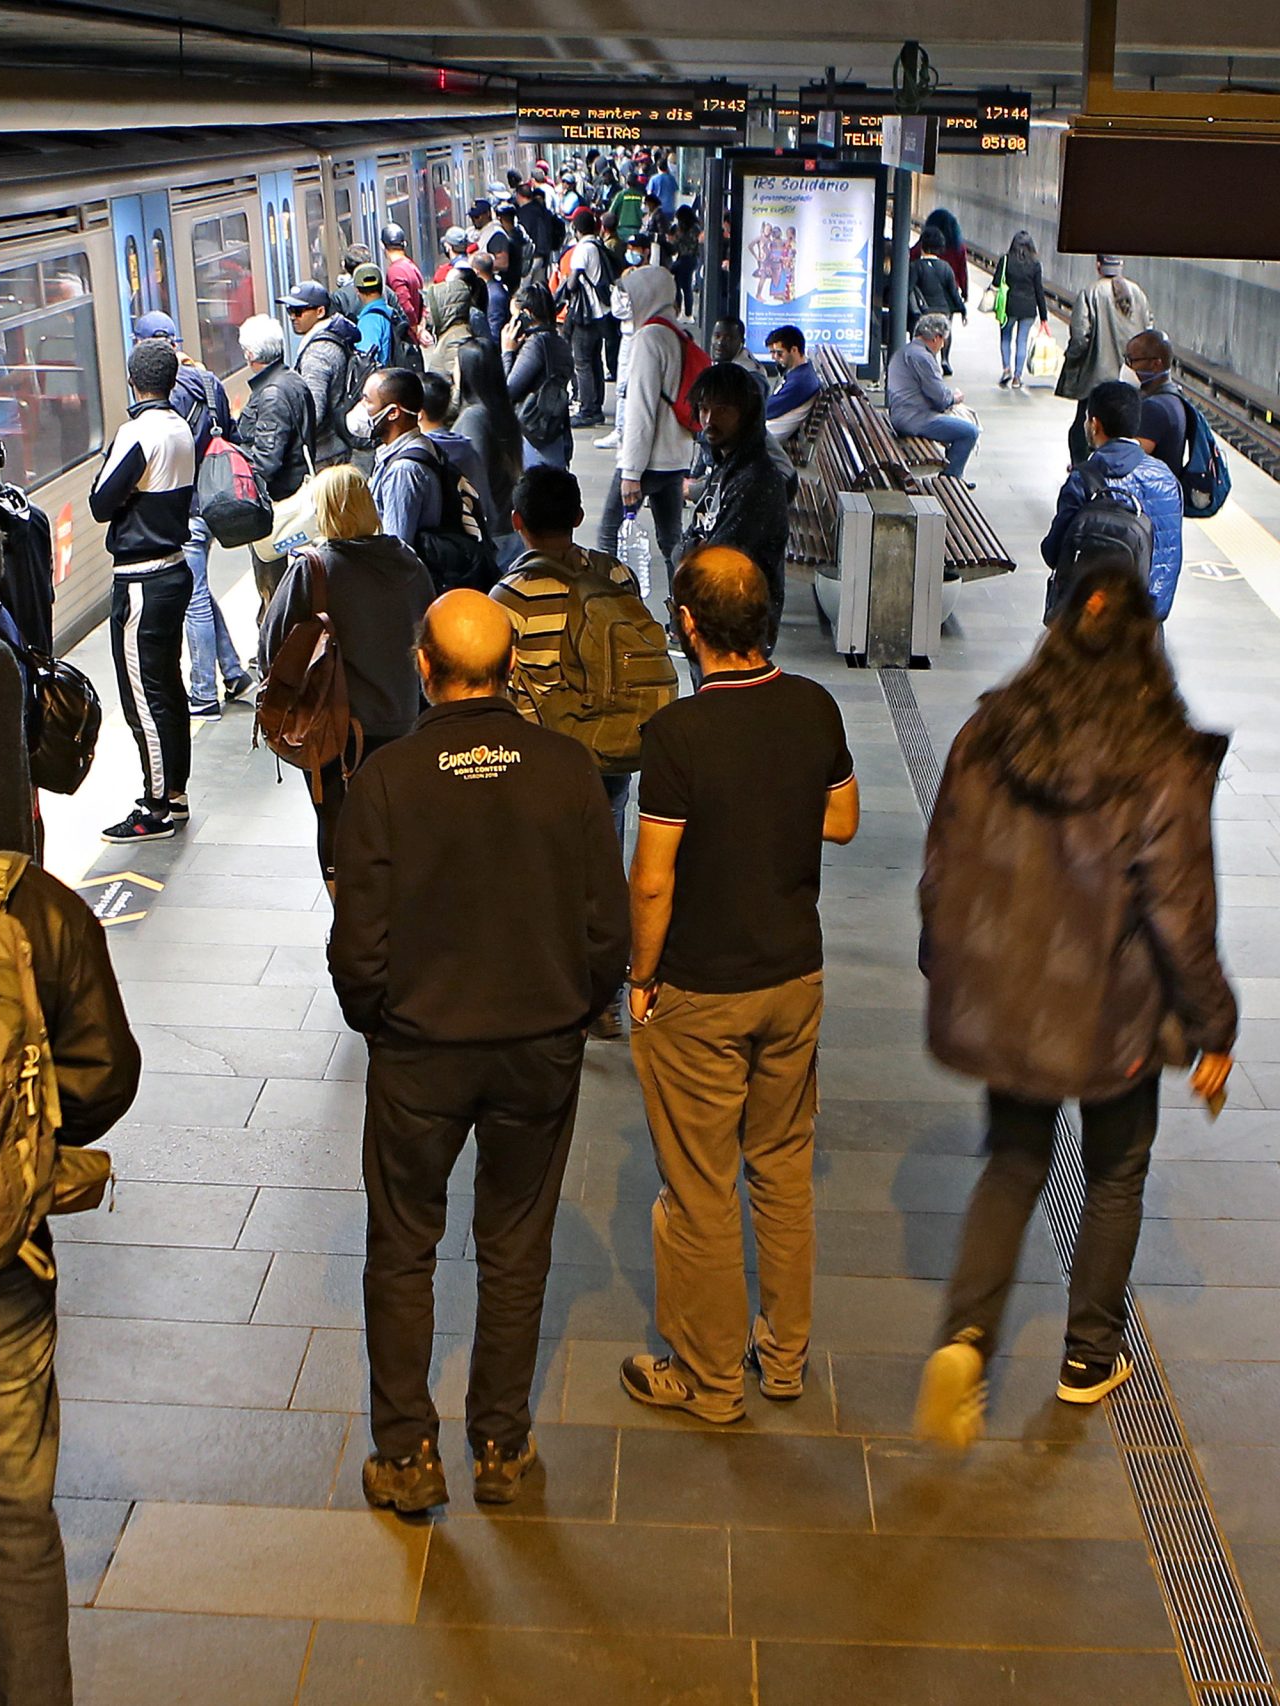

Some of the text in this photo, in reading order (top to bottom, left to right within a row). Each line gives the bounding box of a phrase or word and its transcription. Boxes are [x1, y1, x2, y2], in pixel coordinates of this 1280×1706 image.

[703, 98, 746, 112] 17:43
[518, 106, 693, 121] procure manter a dis
[985, 106, 1029, 121] 17:44
[561, 125, 641, 139] TELHEIRAS
[981, 135, 1027, 151] 05:00
[753, 176, 777, 190] IRS
[834, 328, 865, 341] 092
[453, 764, 508, 776] SONG CONTEST
